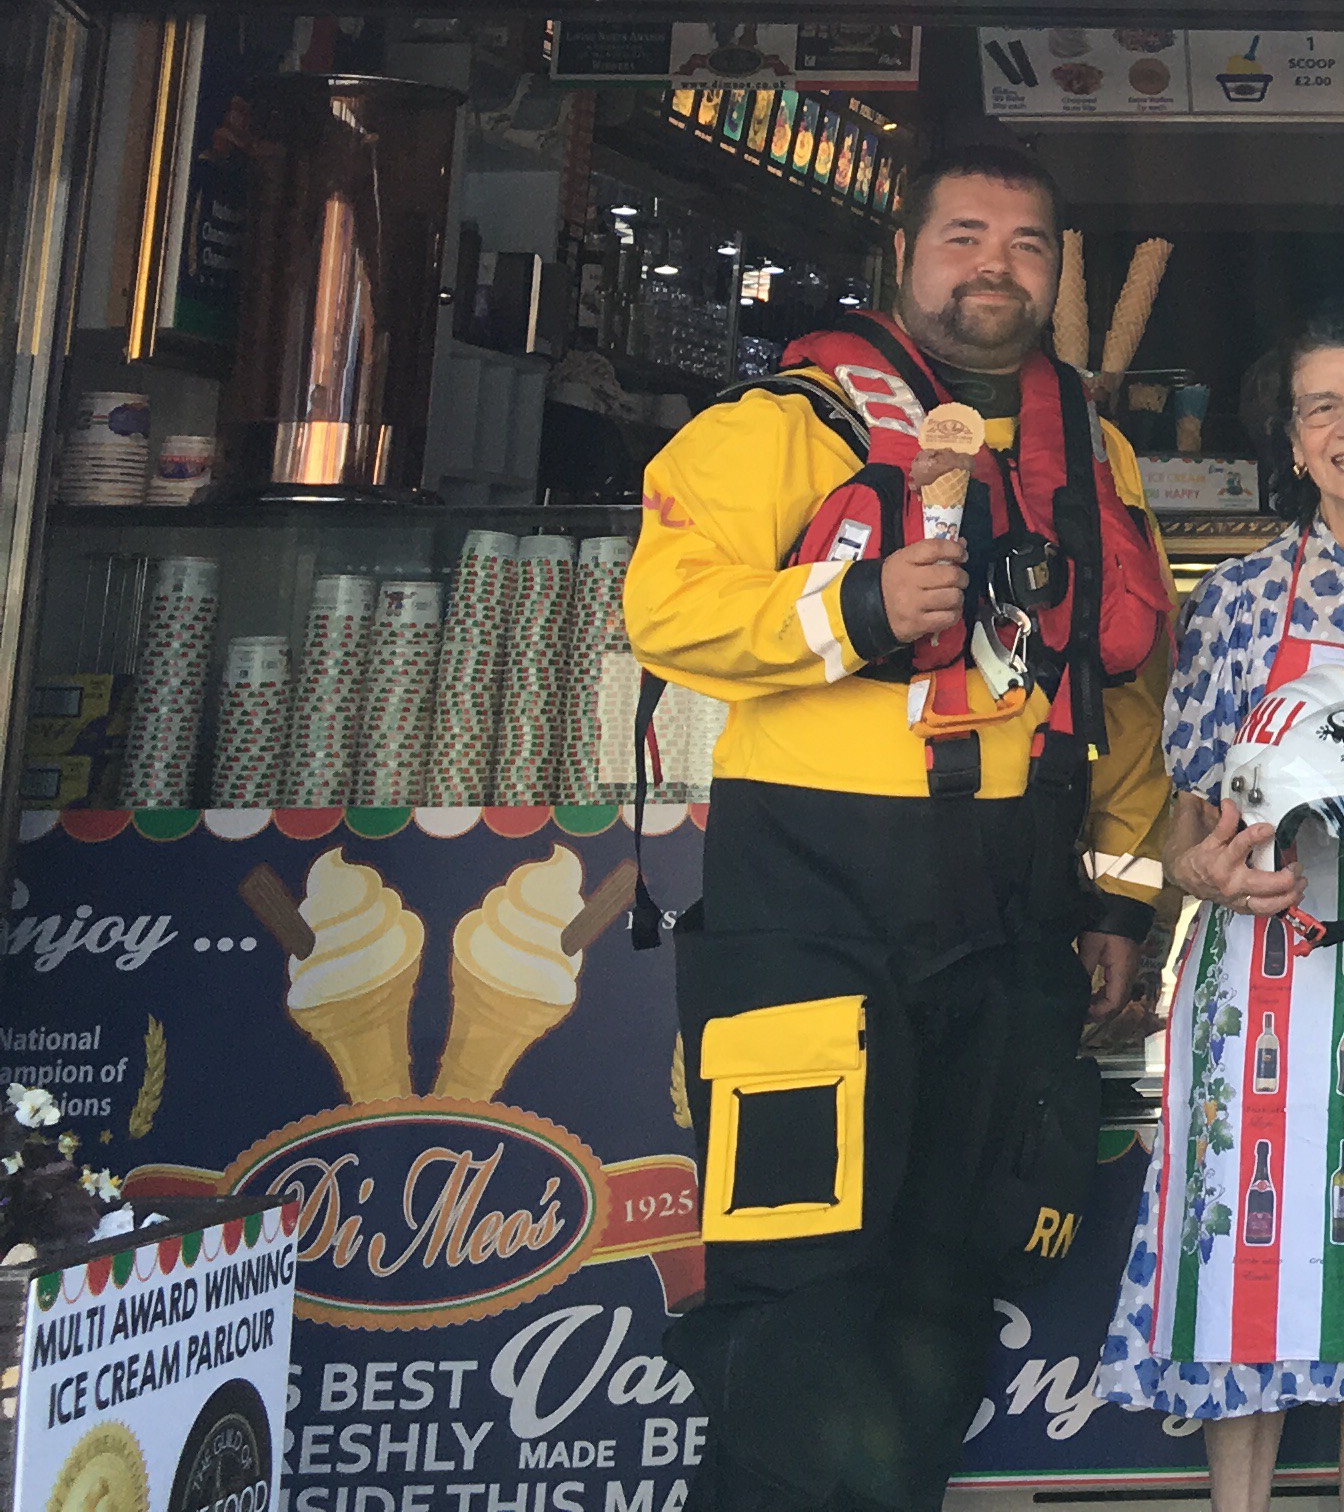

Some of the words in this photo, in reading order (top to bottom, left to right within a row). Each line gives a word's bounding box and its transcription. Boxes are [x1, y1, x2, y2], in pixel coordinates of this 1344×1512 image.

[1288, 58, 1337, 70] SCOOP
[1294, 76, 1332, 87] £2.00
[0, 888, 178, 973] njoy
[100, 1056, 129, 1084] of
[367, 1142, 567, 1278] Meo's
[622, 1190, 694, 1224] 1925
[30, 1304, 106, 1372] MULTI
[109, 1276, 200, 1346] AWARD
[204, 1241, 294, 1313] WINNING
[47, 1370, 90, 1430] ICE
[94, 1338, 181, 1413] CREAM
[184, 1307, 276, 1379] PARLOUR
[319, 1360, 479, 1412] BEST
[518, 1439, 617, 1470] MADE
